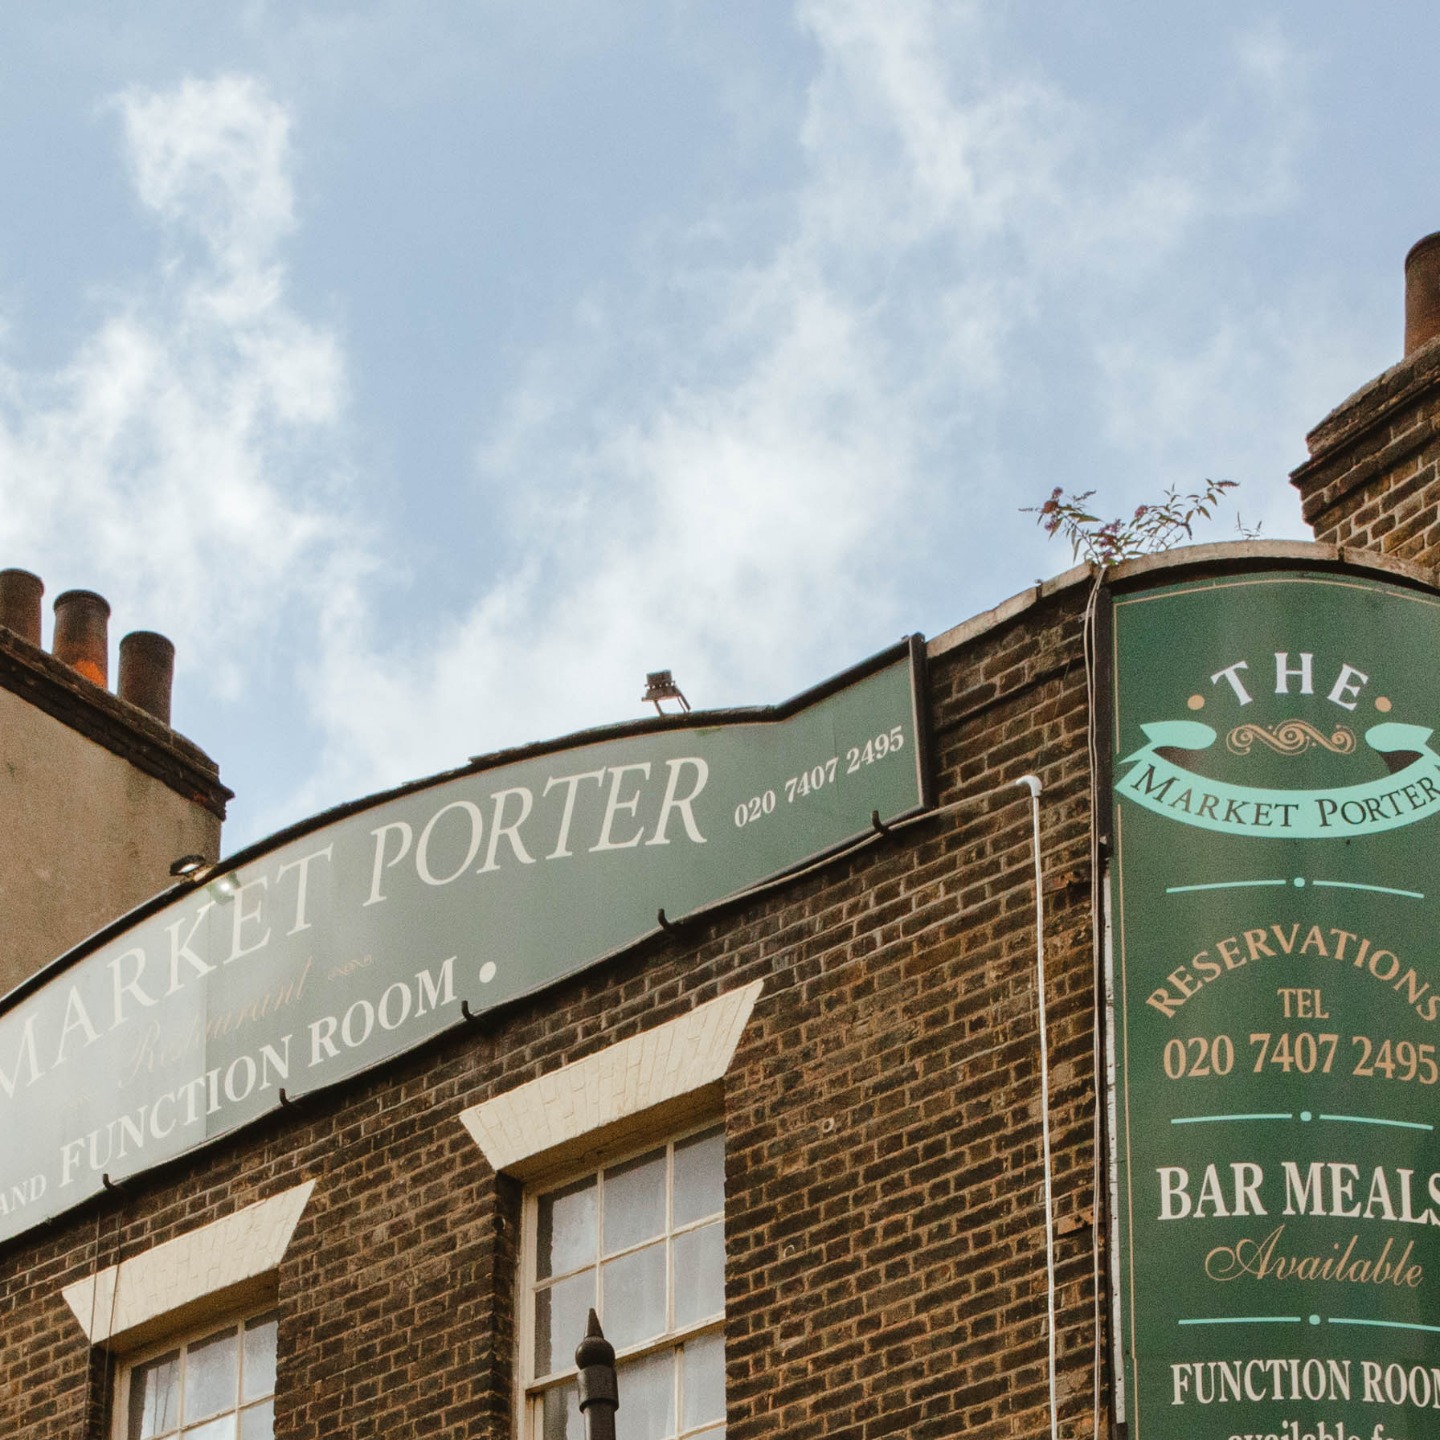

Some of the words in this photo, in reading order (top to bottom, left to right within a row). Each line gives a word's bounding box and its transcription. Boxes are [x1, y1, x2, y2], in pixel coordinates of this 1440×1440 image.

[1211, 652, 1369, 711] THE
[734, 793, 776, 828] 020
[785, 757, 838, 804] 7407
[847, 725, 904, 773] 2495
[1130, 763, 1298, 827] MARKET
[363, 756, 709, 907] PORTER
[1277, 988, 1329, 1019] TEL
[60, 1031, 291, 1184] FUNCTION
[307, 955, 457, 1068] ROOM
[1163, 1036, 1234, 1081] 020
[1249, 1032, 1338, 1074] 7407
[1351, 1036, 1439, 1085] 2495
[1156, 1161, 1268, 1221] BAR
[1204, 1224, 1424, 1288] Available
[1170, 1358, 1352, 1406] FUNCTION
